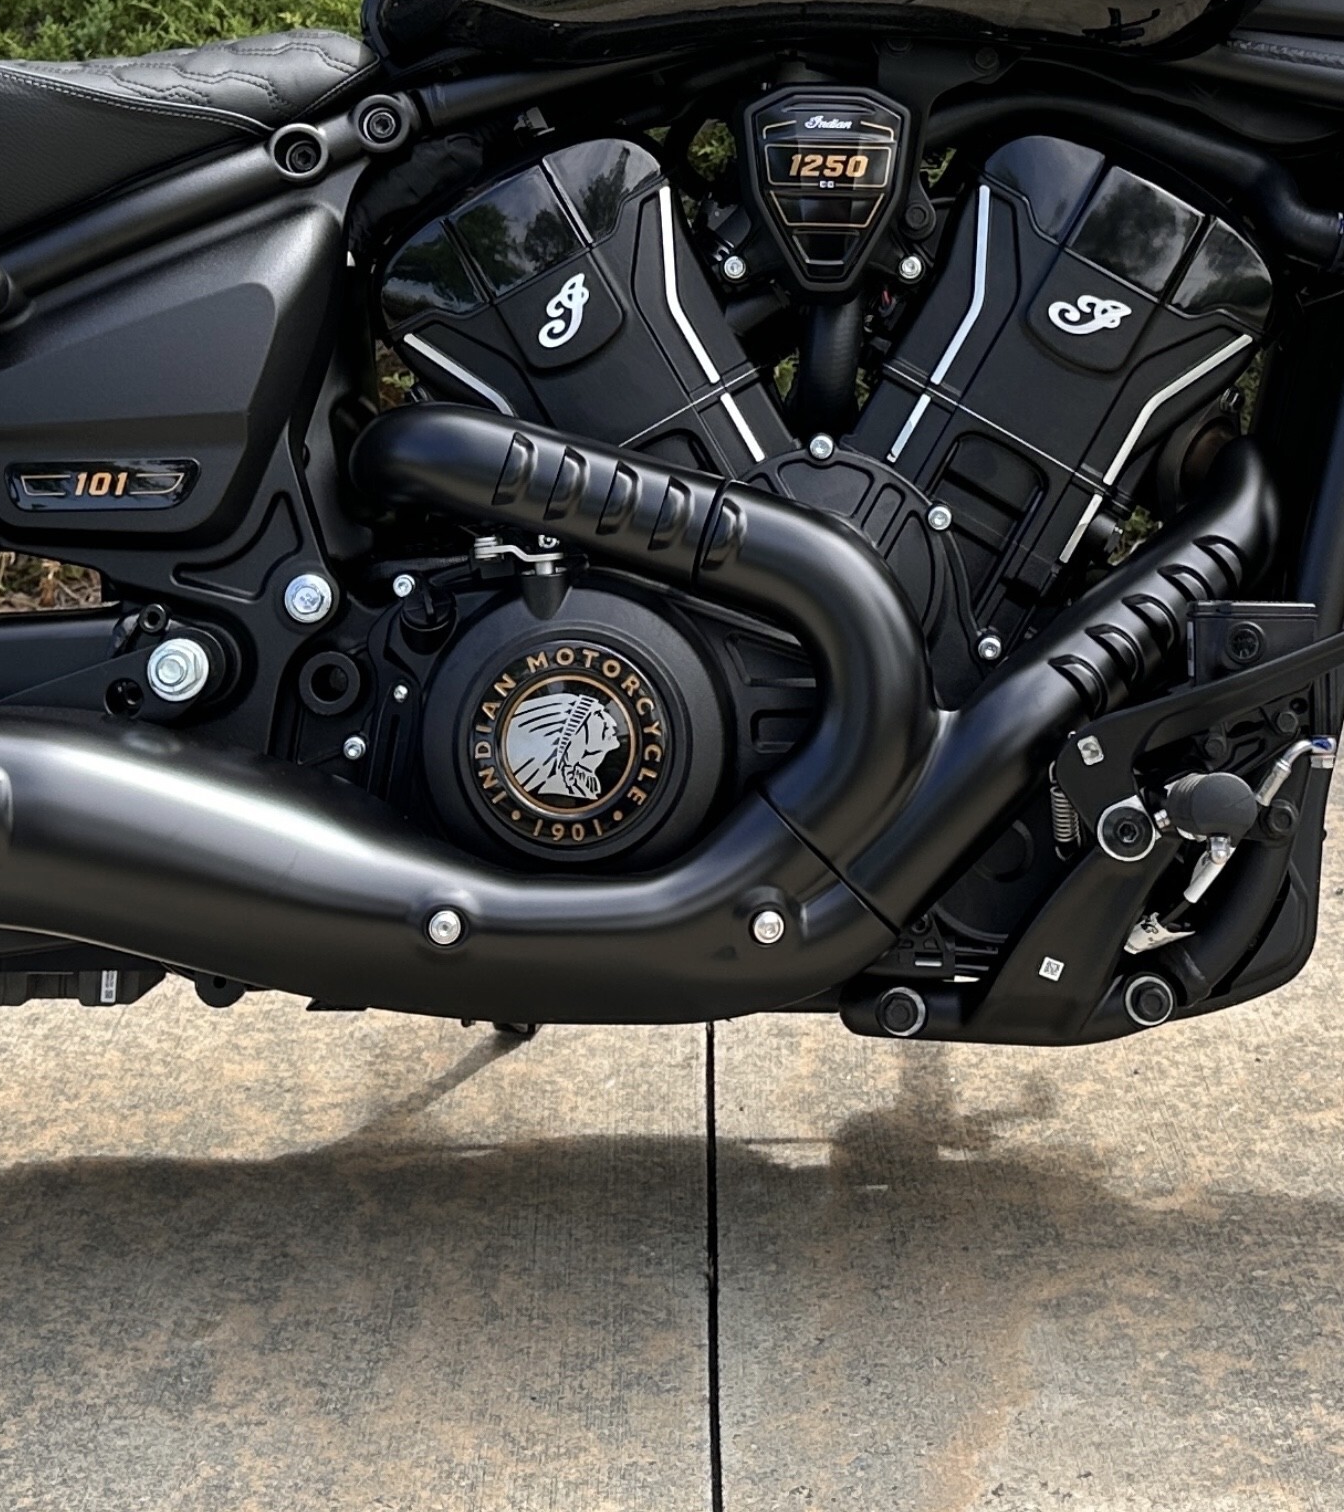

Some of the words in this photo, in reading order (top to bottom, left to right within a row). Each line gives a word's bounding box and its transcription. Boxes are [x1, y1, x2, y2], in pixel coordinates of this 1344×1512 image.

[804, 115, 853, 129] Indian
[789, 153, 869, 178] 1250
[74, 471, 129, 496] 101
[474, 673, 517, 804] INDIAN
[526, 647, 663, 806] MOTORCYCLE
[533, 818, 604, 842] 1901
